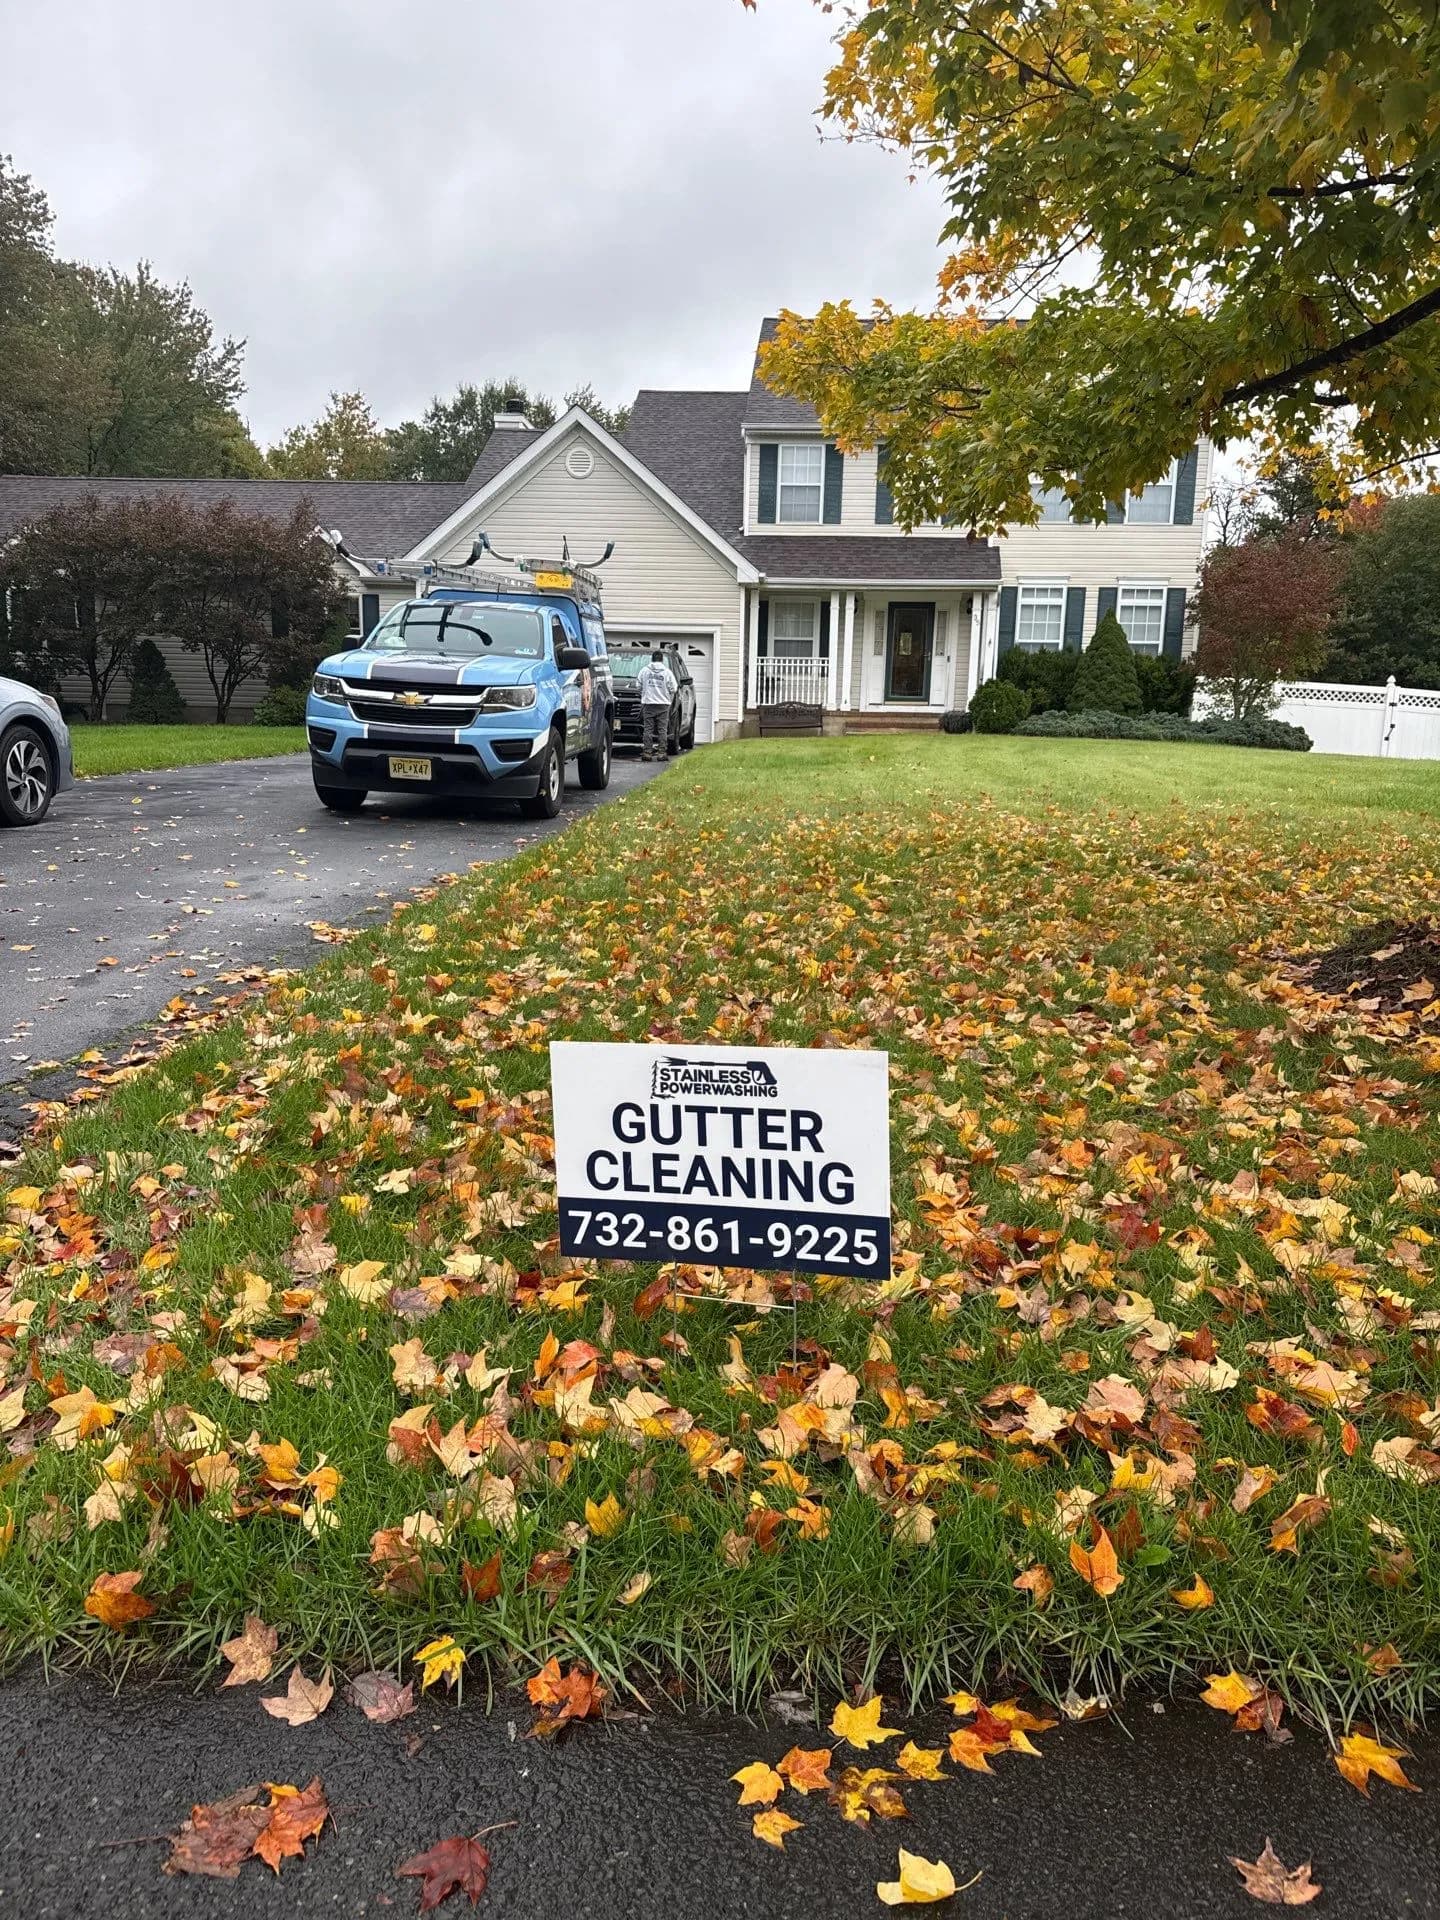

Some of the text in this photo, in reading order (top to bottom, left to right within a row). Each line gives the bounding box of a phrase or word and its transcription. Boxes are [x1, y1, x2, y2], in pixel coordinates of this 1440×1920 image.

[660, 1069, 751, 1084] STAINLESS
[660, 1082, 778, 1098] POWERWASHING
[612, 1102, 824, 1153] GUTTER
[586, 1150, 855, 1204] CLEANING
[568, 1210, 878, 1265] 732-861-9225
